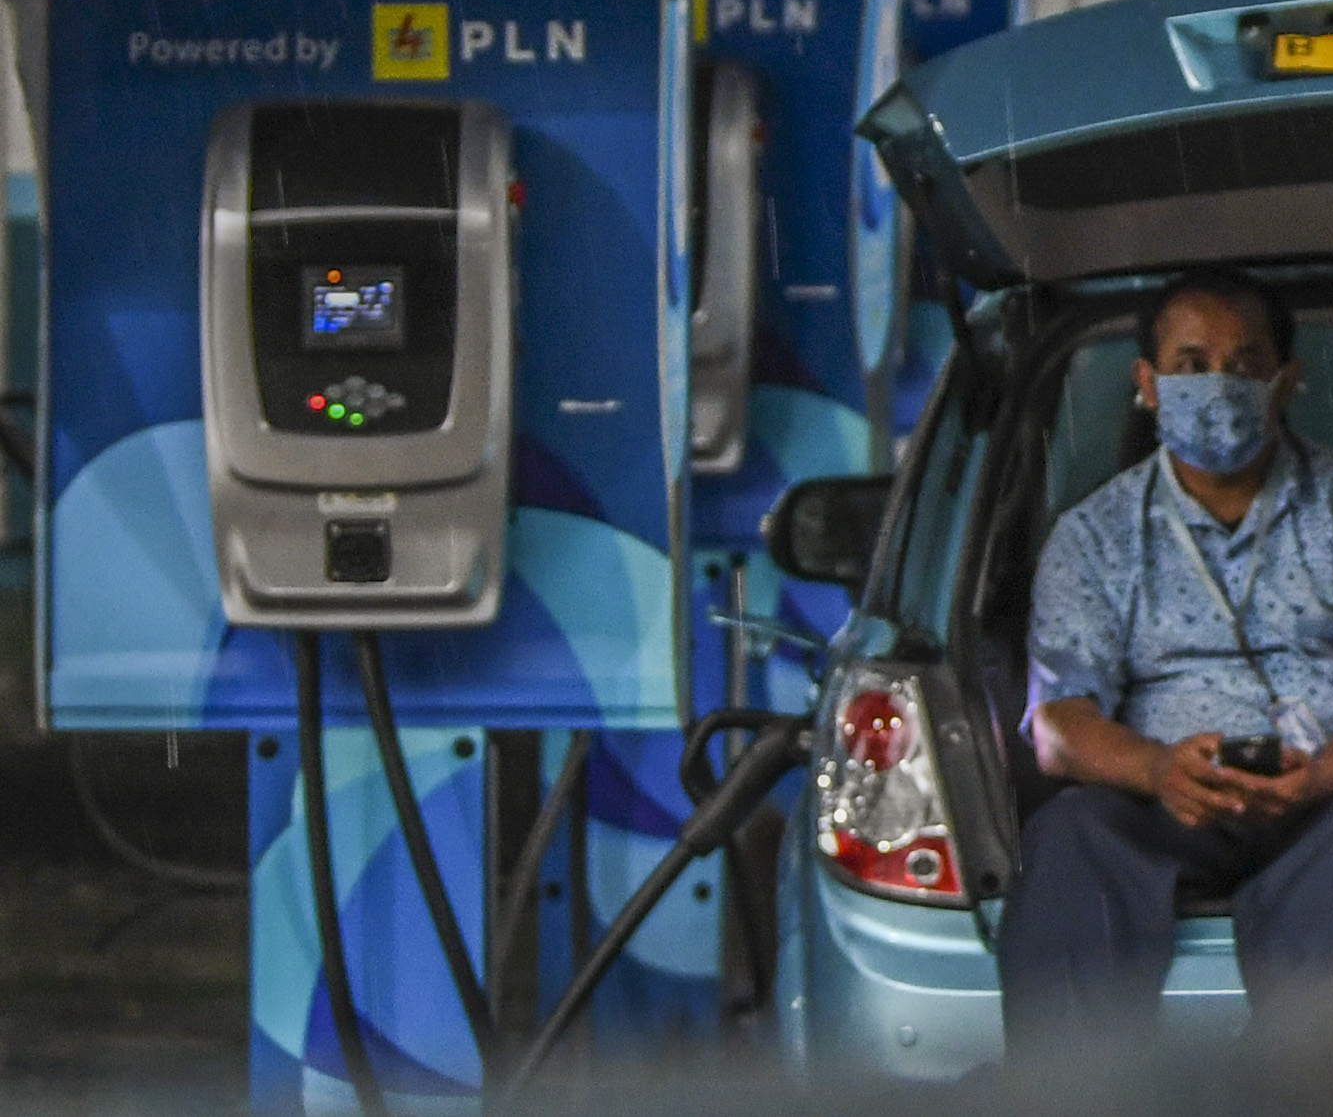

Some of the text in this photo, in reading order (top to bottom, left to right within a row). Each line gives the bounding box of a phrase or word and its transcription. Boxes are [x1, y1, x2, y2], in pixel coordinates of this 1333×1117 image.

[129, 29, 340, 70] Powered by
[461, 21, 586, 62] PLN
[1286, 37, 1313, 57] B
